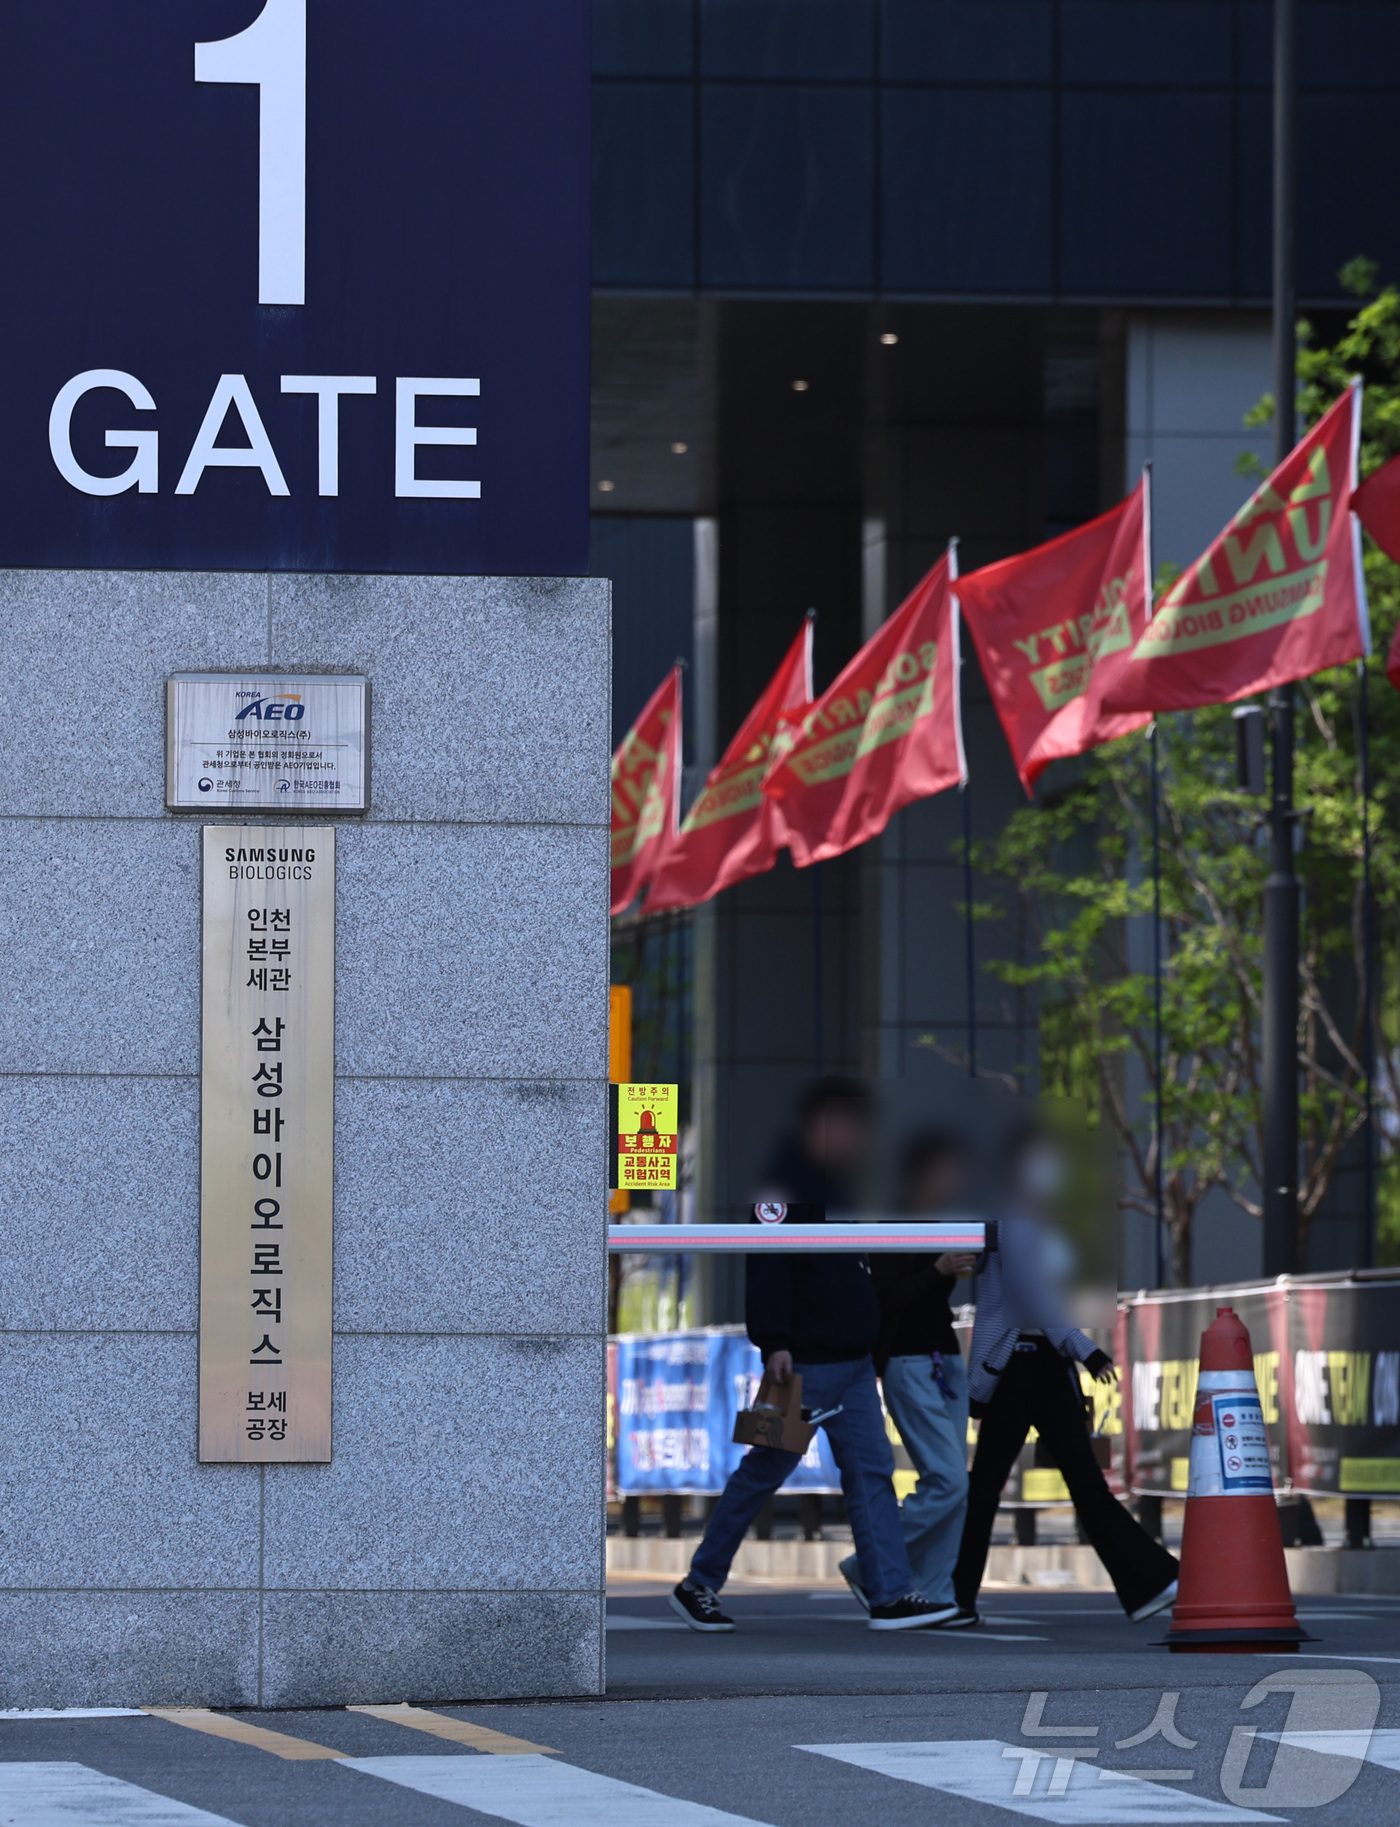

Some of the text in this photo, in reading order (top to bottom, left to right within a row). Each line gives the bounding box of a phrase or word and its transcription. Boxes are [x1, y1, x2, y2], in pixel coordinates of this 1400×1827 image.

[194, 0, 306, 305] 1
[49, 368, 481, 498] GATE
[235, 696, 305, 721] AEO
[228, 729, 311, 740] 삼성바이오로직스(주)
[202, 760, 336, 770] 관세청으로부터 공인받은 AEO기업입니다.
[216, 750, 223, 758] 위
[225, 750, 246, 758] 기업은
[249, 750, 255, 758] 본
[281, 751, 322, 759] 정회원으로서
[216, 780, 340, 789] 관세청 한국AEO진흥협회
[225, 848, 315, 862] SAMSUNG
[229, 866, 312, 880] BIOLOGICS
[247, 909, 291, 931] 인천
[247, 938, 291, 961] 본부
[246, 968, 291, 991] 세관
[624, 1157, 670, 1167] 교통사고
[624, 1169, 670, 1180] 위험지역
[250, 1017, 286, 1364] 삼성바이오로직스
[246, 1391, 287, 1412] 보세
[246, 1419, 287, 1440] 공장
